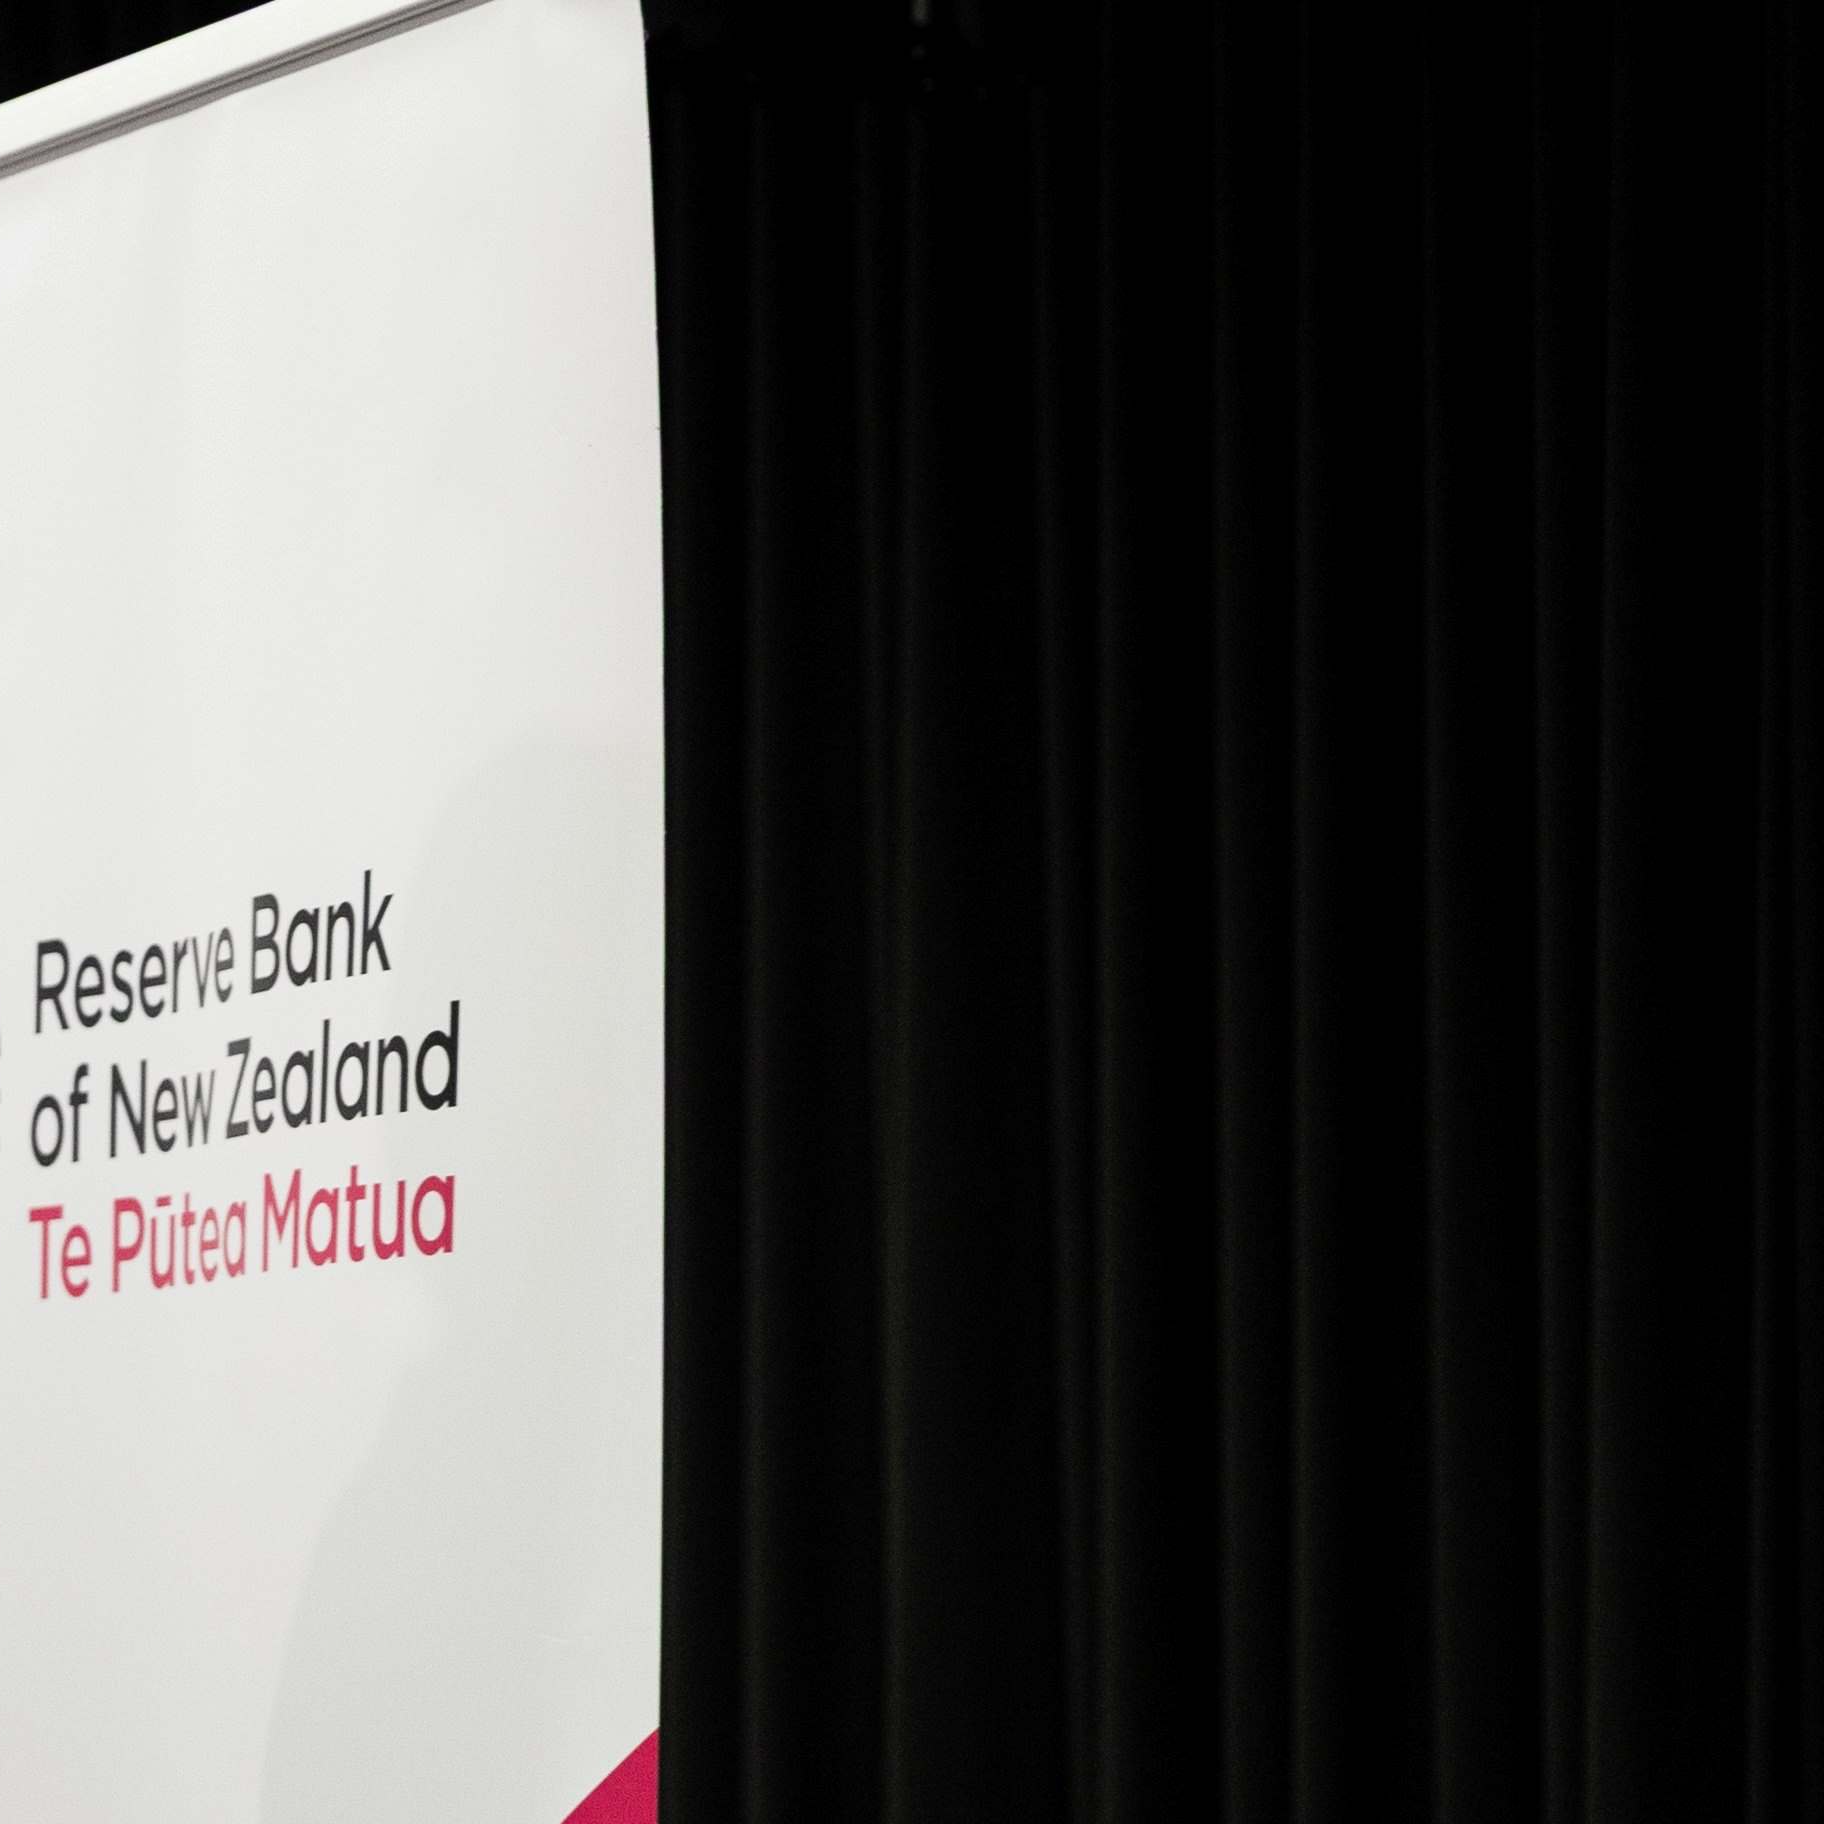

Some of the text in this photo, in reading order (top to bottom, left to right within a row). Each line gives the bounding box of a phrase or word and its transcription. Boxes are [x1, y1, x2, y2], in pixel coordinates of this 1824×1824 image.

[34, 868, 396, 1035] Reserve Bank
[29, 999, 461, 1169] of New Zealand
[27, 1164, 457, 1300] Te Pūtea Matua
